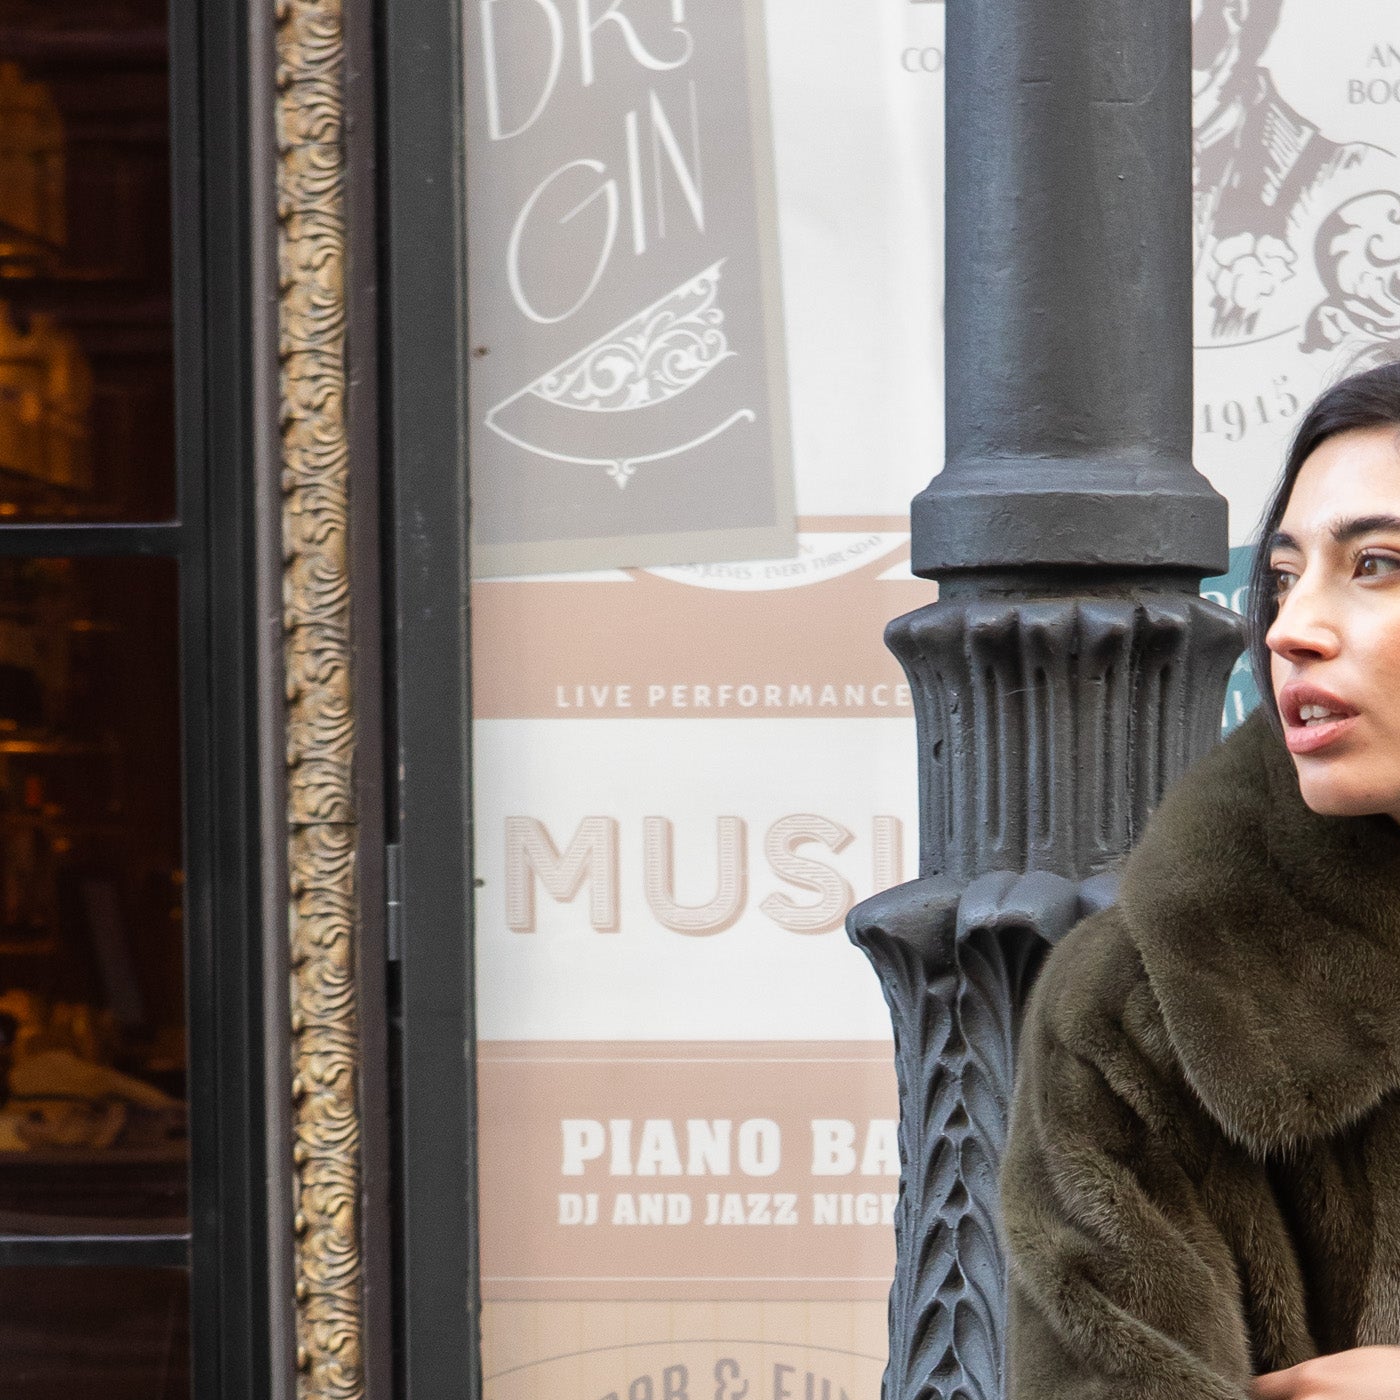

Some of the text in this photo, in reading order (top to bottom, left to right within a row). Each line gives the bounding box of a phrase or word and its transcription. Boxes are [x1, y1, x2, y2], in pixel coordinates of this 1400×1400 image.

[478, 0, 694, 141] DR
[507, 80, 705, 324] GIN
[1200, 375, 1298, 442] 1915
[556, 684, 632, 708] LIVE
[560, 1118, 781, 1176] PIANO
[558, 1194, 598, 1225] DJ
[611, 1194, 692, 1225] AND
[704, 1194, 798, 1225] JAZZ
